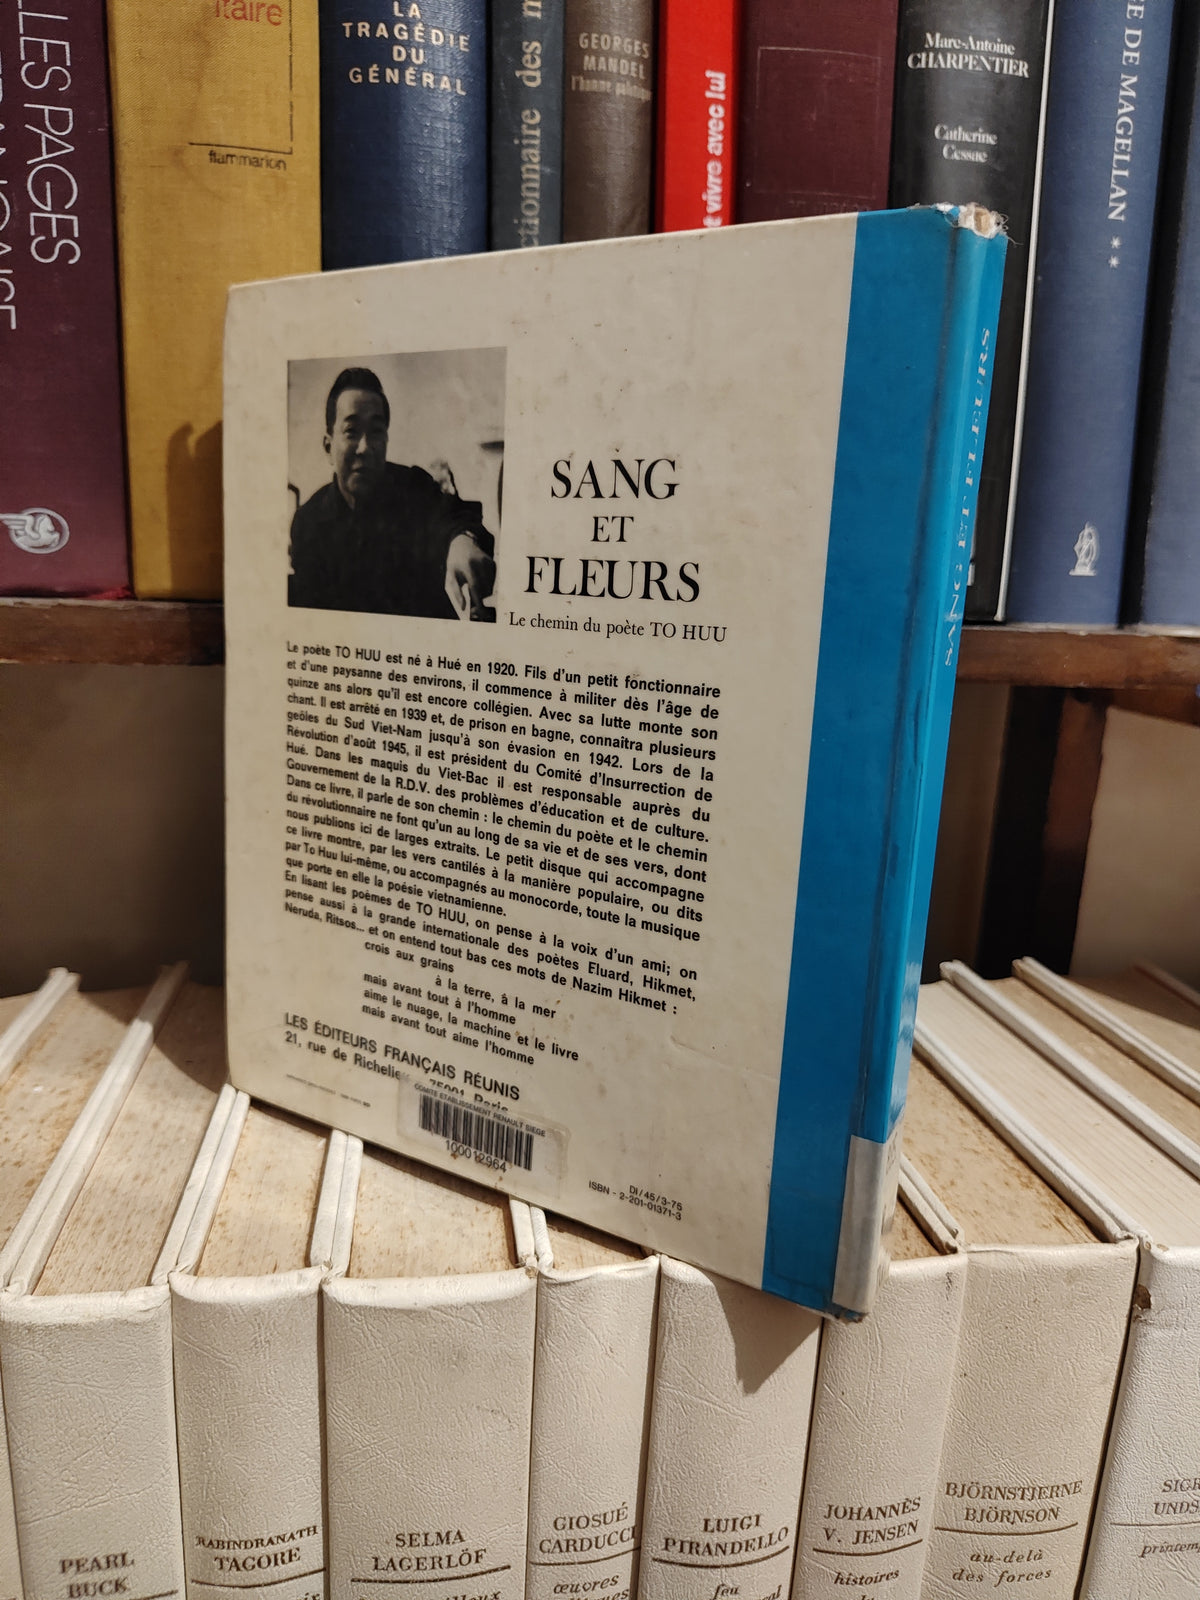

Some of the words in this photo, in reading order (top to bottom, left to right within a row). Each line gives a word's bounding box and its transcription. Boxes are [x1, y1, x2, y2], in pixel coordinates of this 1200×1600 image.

[393, 1, 421, 19] LA
[18, 0, 72, 91] LES
[342, 22, 471, 52] TRAGÉDIE
[579, 32, 649, 59] GEORGES
[924, 32, 1016, 55] Marc-Antoine
[1121, 27, 1142, 66] DE
[392, 45, 424, 64] DU
[515, 41, 542, 88] des
[583, 55, 646, 80] MANDEL
[907, 51, 1030, 78] CHARPENTIER
[348, 63, 467, 96] GÉNÉRAL
[705, 69, 726, 100] lui
[707, 104, 725, 156] avec
[934, 123, 998, 145] Catherine
[208, 150, 287, 171] flammarion
[1107, 73, 1139, 222] MAGELLAN
[24, 103, 81, 264] PAGES
[702, 160, 723, 213] vivre
[551, 458, 680, 500] SANG
[591, 516, 634, 543] ET
[524, 556, 700, 603] FLEURS
[509, 611, 526, 627] Le
[530, 613, 578, 631] chemin
[583, 616, 601, 632] du
[606, 619, 645, 638] poète
[650, 621, 676, 638] TO
[682, 624, 727, 642] HUU
[287, 641, 299, 653] Le
[303, 645, 331, 657] poète
[335, 646, 351, 659] TO
[355, 648, 381, 662] HUU
[386, 654, 403, 664] est
[408, 654, 421, 666] né
[426, 655, 433, 667] à
[438, 656, 462, 671] Hué
[467, 663, 481, 673] en
[488, 662, 518, 677] 1920.
[525, 665, 547, 680] Fils
[553, 668, 581, 684] d'un
[588, 674, 619, 688] petit
[625, 675, 721, 698] fonctionnaire
[287, 692, 317, 706] chant.
[320, 696, 327, 708] Il
[330, 700, 346, 710] est
[349, 702, 380, 715] arrêté
[384, 708, 397, 717] en
[402, 707, 427, 722] 1939
[431, 713, 445, 726] et,
[450, 713, 465, 727] de
[469, 718, 507, 733] prison
[511, 725, 526, 736] en
[532, 724, 574, 744] bagne,
[580, 734, 643, 752] connaîtra
[649, 740, 716, 761] plusieurs
[315, 746, 341, 761] Dans
[348, 752, 363, 765] les
[370, 758, 408, 773] maquis
[416, 763, 430, 776] du
[438, 766, 488, 786] Viet-Bac
[498, 776, 504, 789] il
[513, 782, 533, 794] est
[542, 786, 622, 808] responsable
[632, 801, 680, 817] auprès
[692, 807, 710, 822] du
[286, 791, 298, 803] du
[302, 795, 376, 819] révolutionnaire
[380, 812, 393, 822] ne
[396, 812, 418, 827] font
[422, 819, 452, 834] qu'un
[457, 827, 470, 837] au
[475, 826, 500, 846] long
[504, 833, 520, 847] de
[524, 840, 538, 850] sa
[543, 841, 562, 855] vie
[566, 847, 579, 858] et
[584, 848, 600, 862] de
[605, 855, 628, 868] ses
[634, 860, 668, 877] vers,
[674, 865, 707, 883] dont
[285, 841, 302, 852] par
[303, 842, 316, 855] To
[318, 846, 338, 861] Huu
[340, 851, 390, 874] lui-même,
[393, 866, 407, 876] ou
[409, 870, 487, 894] accompagnés
[491, 888, 505, 898] au
[509, 891, 582, 918] monocorde,
[586, 906, 620, 924] toute
[625, 913, 637, 928] la
[641, 920, 701, 942] musique
[364, 942, 390, 955] crois
[396, 950, 414, 962] aux
[420, 957, 454, 973] grains
[364, 989, 388, 1004] aime
[392, 995, 402, 1008] le
[407, 1003, 443, 1022] nuage,
[448, 1012, 458, 1025] la
[464, 1020, 511, 1041] machine
[517, 1034, 529, 1047] et
[532, 1036, 546, 1052] le
[552, 1043, 579, 1061] livre
[285, 1012, 308, 1031] LES
[314, 1020, 377, 1054] ÉDITEURS
[384, 1044, 456, 1080] FRANÇAIS
[463, 1070, 520, 1101] RÉUNIS
[307, 1041, 327, 1054] rue
[333, 1047, 348, 1062] de
[353, 1053, 410, 1083] Richelie
[589, 1180, 610, 1195] ISBN
[619, 1191, 682, 1221] 2-201-01371-3
[945, 1480, 1083, 1501] BJÖRNSTJERNE
[553, 1501, 629, 1532] GIOSUÉ
[702, 1514, 762, 1534] LUIGI
[964, 1506, 1060, 1524] BJÖRNSON
[195, 1525, 319, 1551] RABINDRANATH
[395, 1529, 466, 1548] SELMA
[539, 1525, 637, 1555] CARDUCCI
[664, 1526, 789, 1557] PIRANDELLO
[822, 1527, 841, 1543] V.
[852, 1519, 919, 1545] JENSEN
[59, 1551, 135, 1574] PEARL
[214, 1547, 301, 1572] TAGORE
[372, 1548, 488, 1572] LAGERLÖF
[970, 1549, 1043, 1563] au-delà
[67, 1577, 129, 1598] BUCK
[553, 1575, 619, 1595] œuvres
[833, 1569, 900, 1586] histoires
[952, 1568, 984, 1583] des
[993, 1569, 1052, 1588] forces
